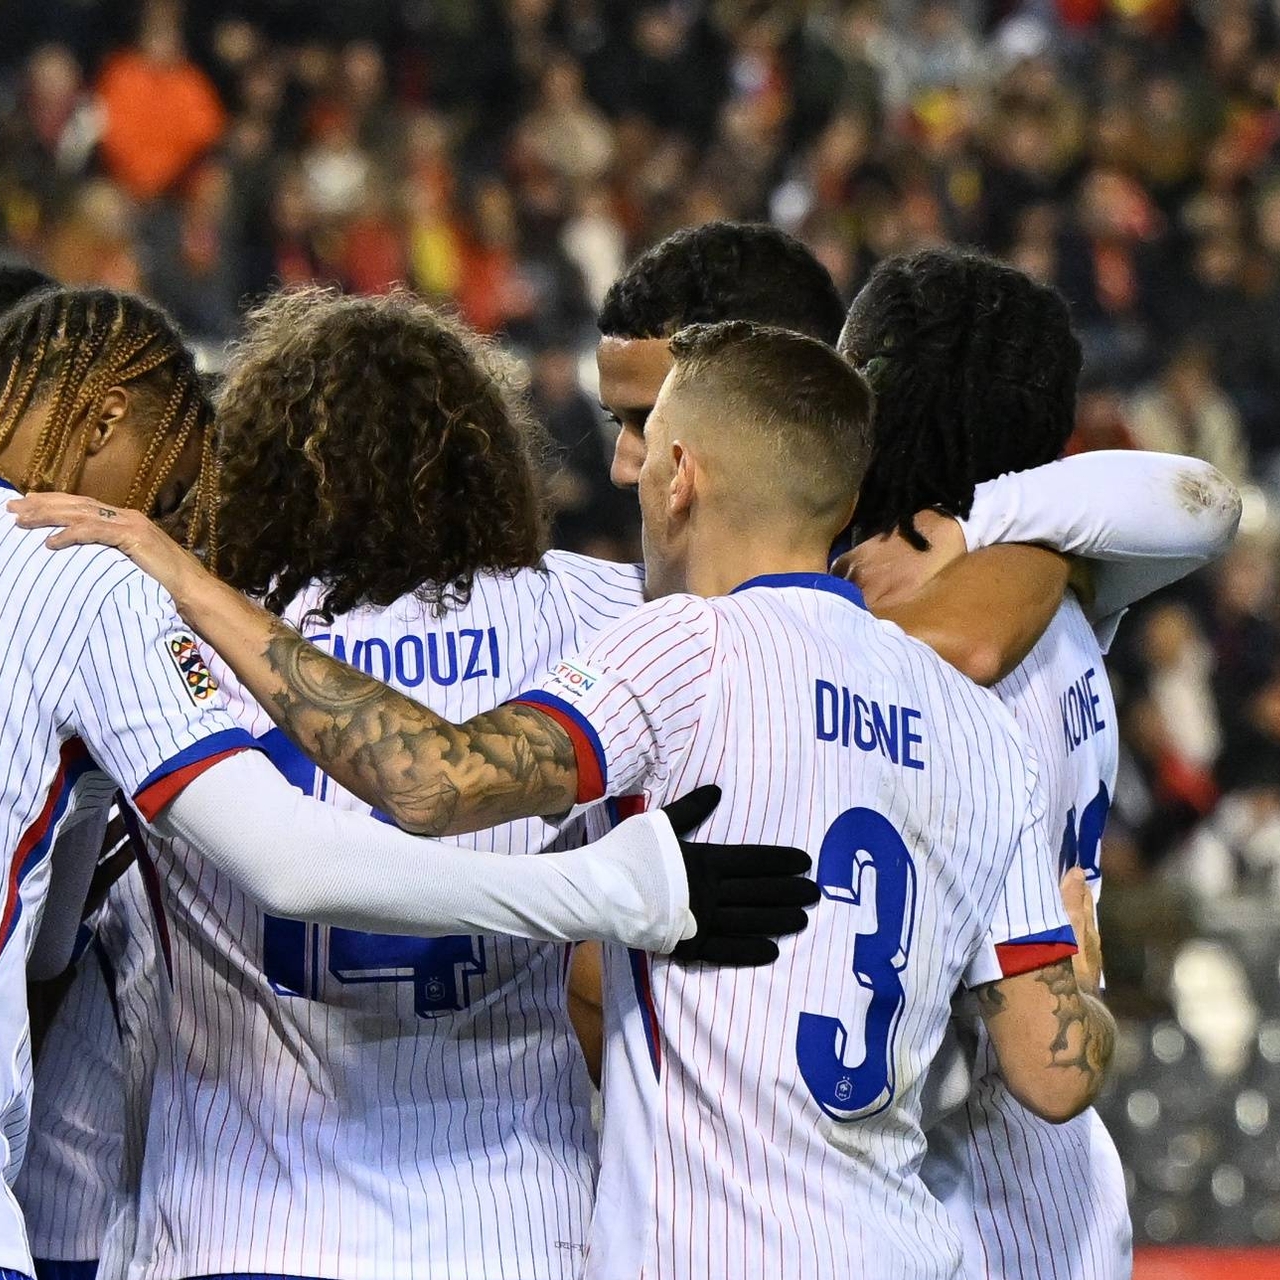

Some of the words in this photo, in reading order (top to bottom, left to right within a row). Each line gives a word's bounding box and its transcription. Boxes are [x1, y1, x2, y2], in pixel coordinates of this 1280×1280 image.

[307, 627, 500, 687] NDOUZI
[815, 679, 925, 770] DIGNE
[1059, 668, 1106, 757] KONE
[796, 807, 917, 1123] 3
